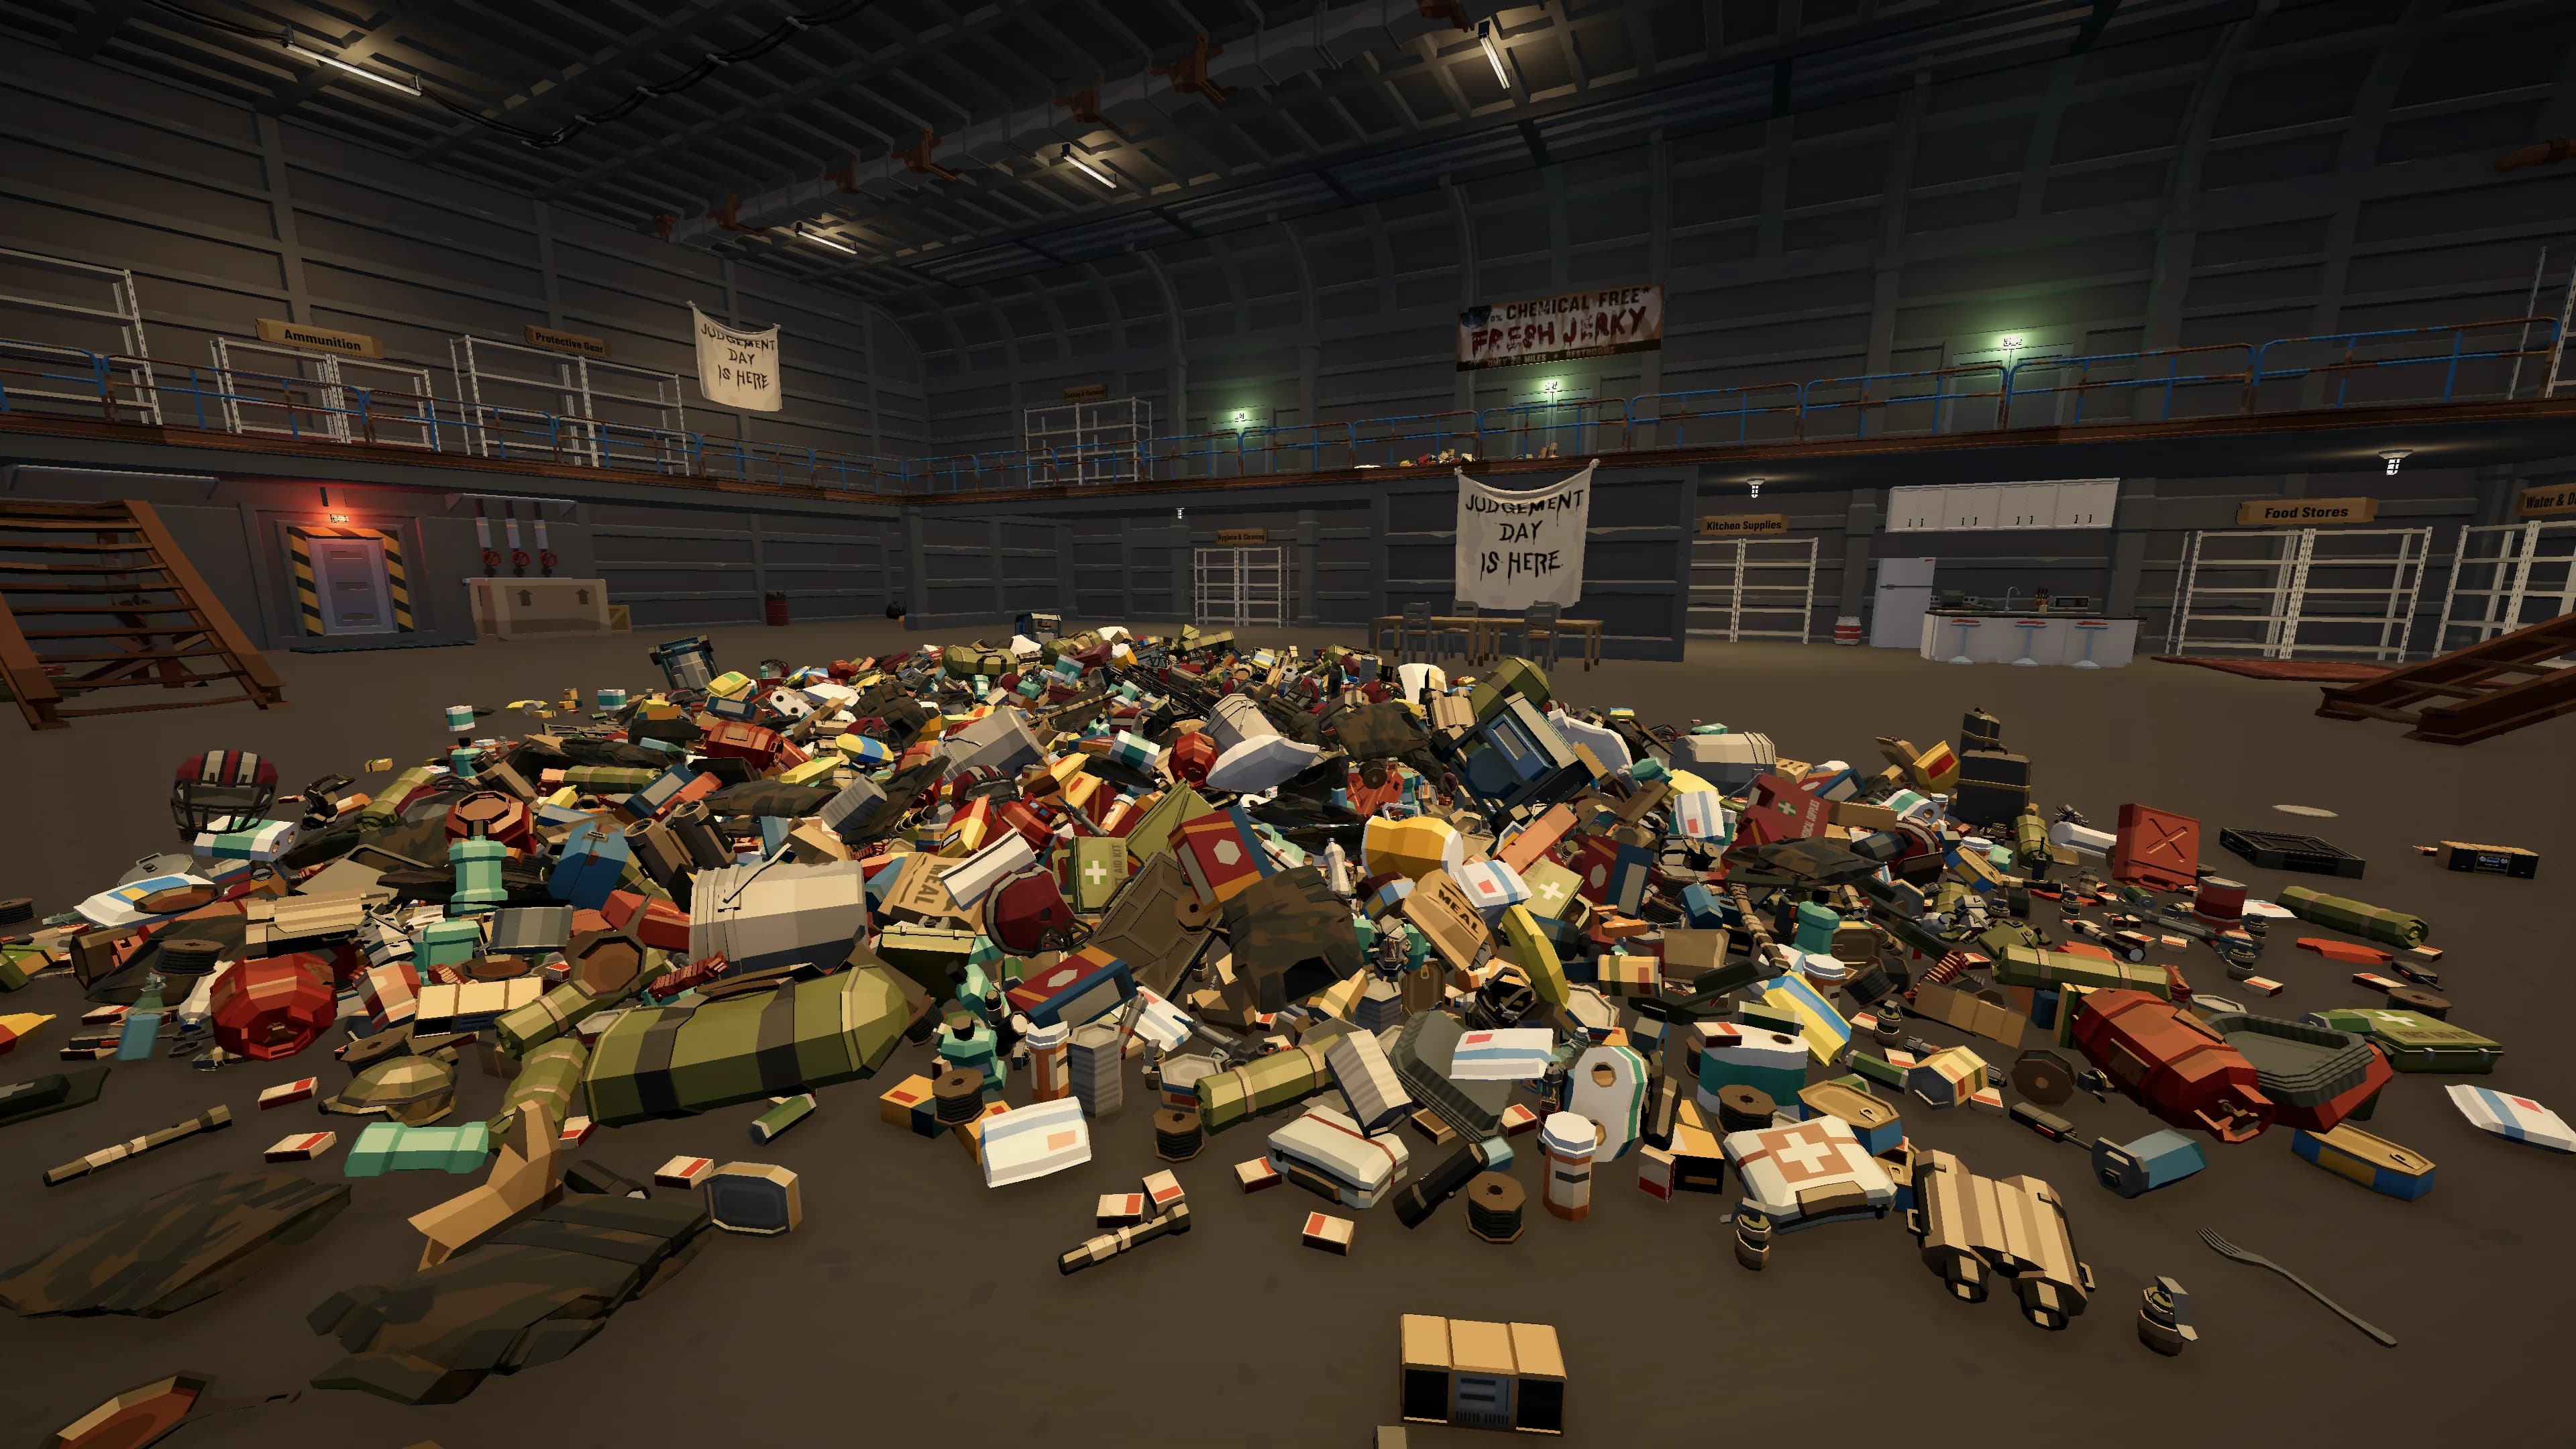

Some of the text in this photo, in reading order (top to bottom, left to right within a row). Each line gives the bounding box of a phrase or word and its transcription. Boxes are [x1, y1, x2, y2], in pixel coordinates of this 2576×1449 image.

[1507, 294, 1589, 320] CHEMICAL
[284, 329, 361, 351] Ammunition
[701, 323, 775, 352] JUDGEMENT
[1472, 306, 1646, 356] FRESH JERKY
[535, 332, 603, 353] Protective Gear
[727, 348, 755, 367] DAY
[1488, 358, 1508, 368] ONLY
[1524, 354, 1546, 363] MILES
[1566, 346, 1615, 358] RESTROOMS
[718, 365, 769, 390] IS HERE
[1466, 490, 1584, 519] JUDGEMENT
[2526, 496, 2555, 508] Water
[2557, 494, 2564, 506] &
[2265, 506, 2349, 519] Food Stores
[1499, 521, 1543, 544] DAY
[1707, 520, 1782, 531] Kitchen Supplies
[1481, 550, 1561, 582] IS HERE
[1801, 820, 1814, 838] EDICAL
[1112, 844, 1122, 857] KIT
[1113, 860, 1123, 873] AID
[914, 865, 953, 904] MEAL
[1438, 889, 1479, 934] MEAL
